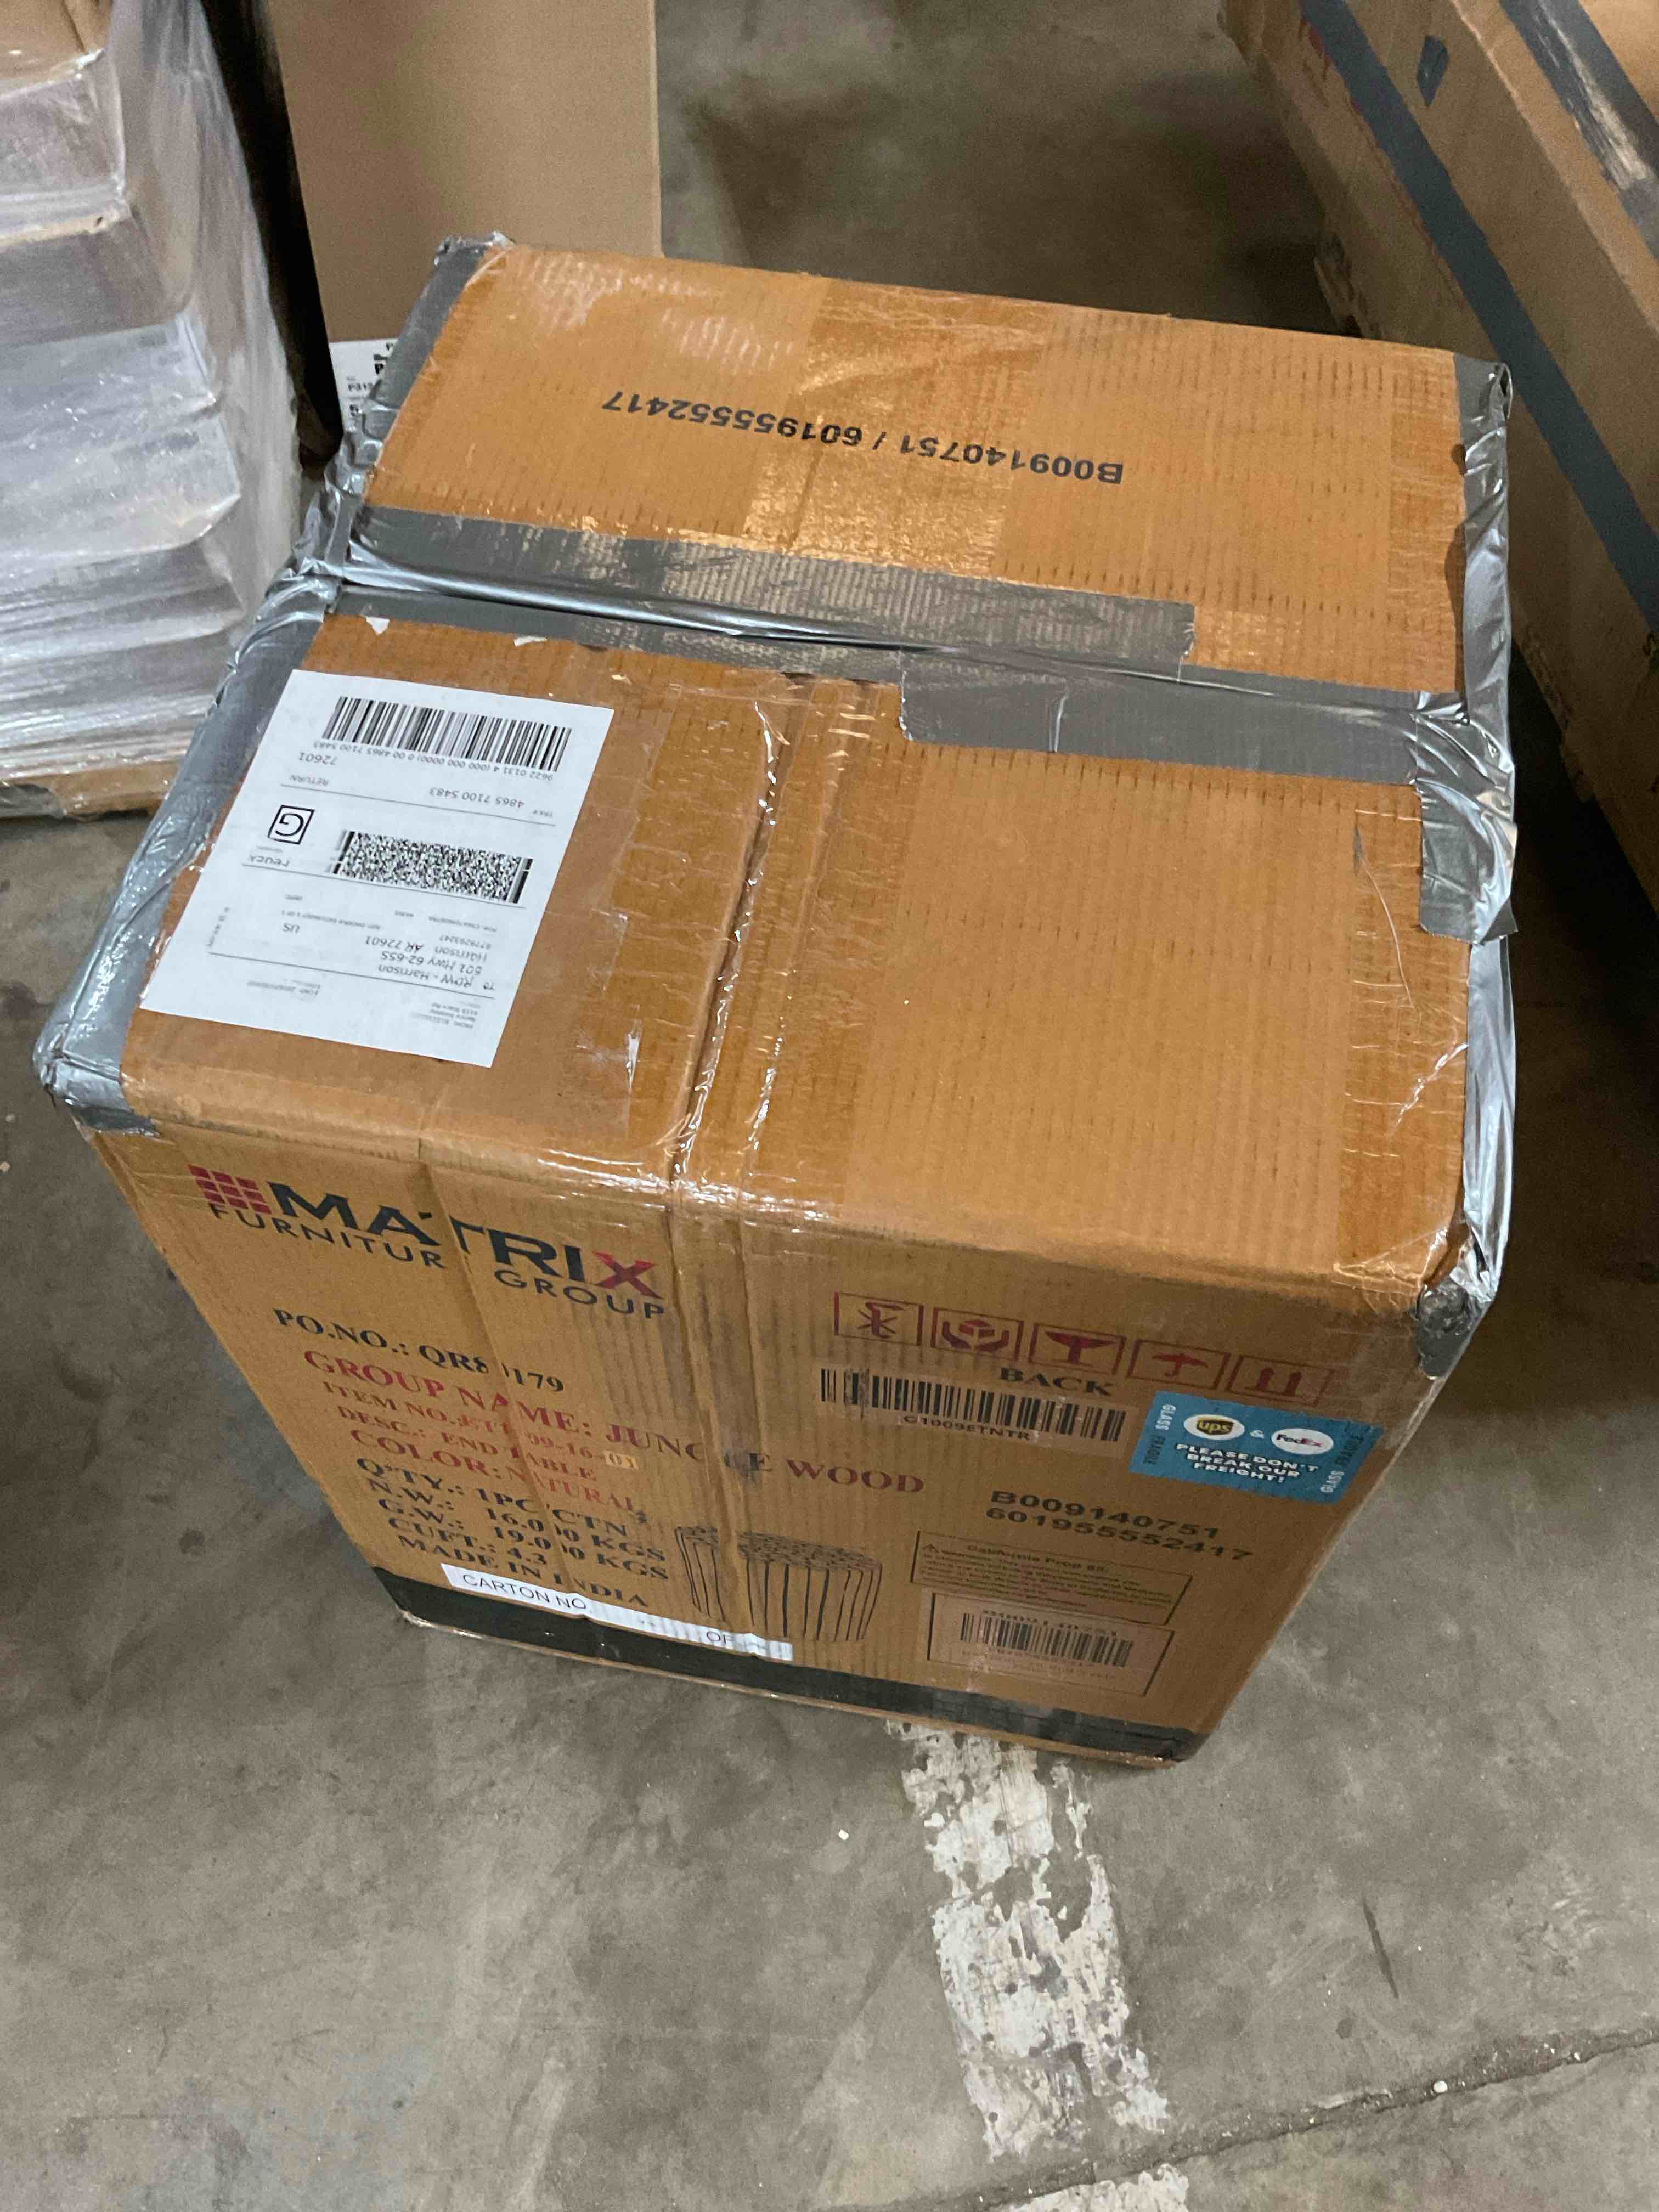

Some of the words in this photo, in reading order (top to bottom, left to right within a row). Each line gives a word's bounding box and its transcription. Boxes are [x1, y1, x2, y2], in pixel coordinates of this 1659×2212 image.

[602, 390, 862, 448] 601955552417
[872, 431, 887, 450] /
[900, 435, 1123, 484] B009140751
[298, 752, 337, 765] 72601
[289, 775, 329, 786] RETURN
[430, 787, 459, 799] 5483
[462, 792, 490, 804] 7100
[495, 797, 524, 808] 4865
[275, 813, 304, 837] G
[281, 923, 300, 933] US
[364, 935, 402, 950] 72601
[208, 1203, 446, 1269] FURNITUR
[494, 1269, 664, 1319] GROUP
[1000, 1367, 1114, 1396] BACK
[323, 1381, 397, 1410] ITEM
[304, 1351, 444, 1396] GROUP
[456, 1385, 592, 1436] NAME:
[786, 1459, 924, 1493] WOOD
[1198, 1421, 1230, 1434] ups
[1277, 1434, 1322, 1447] FedEx
[351, 1430, 501, 1480] COLOR:
[442, 1431, 498, 1454] END
[1176, 1443, 1248, 1460] PLEASE
[1252, 1456, 1319, 1472] DON'T
[1187, 1453, 1251, 1469] BREAK
[1258, 1465, 1300, 1477] OUR
[1194, 1462, 1285, 1483] FREIGHT!
[990, 1491, 1219, 1539] B009140751
[591, 1534, 665, 1561] KGS
[986, 1508, 1254, 1561] 601955552417
[398, 1536, 499, 1568] MADE
[508, 1561, 541, 1579] IN
[597, 1553, 668, 1579] KGS
[462, 1574, 550, 1604] CARTON
